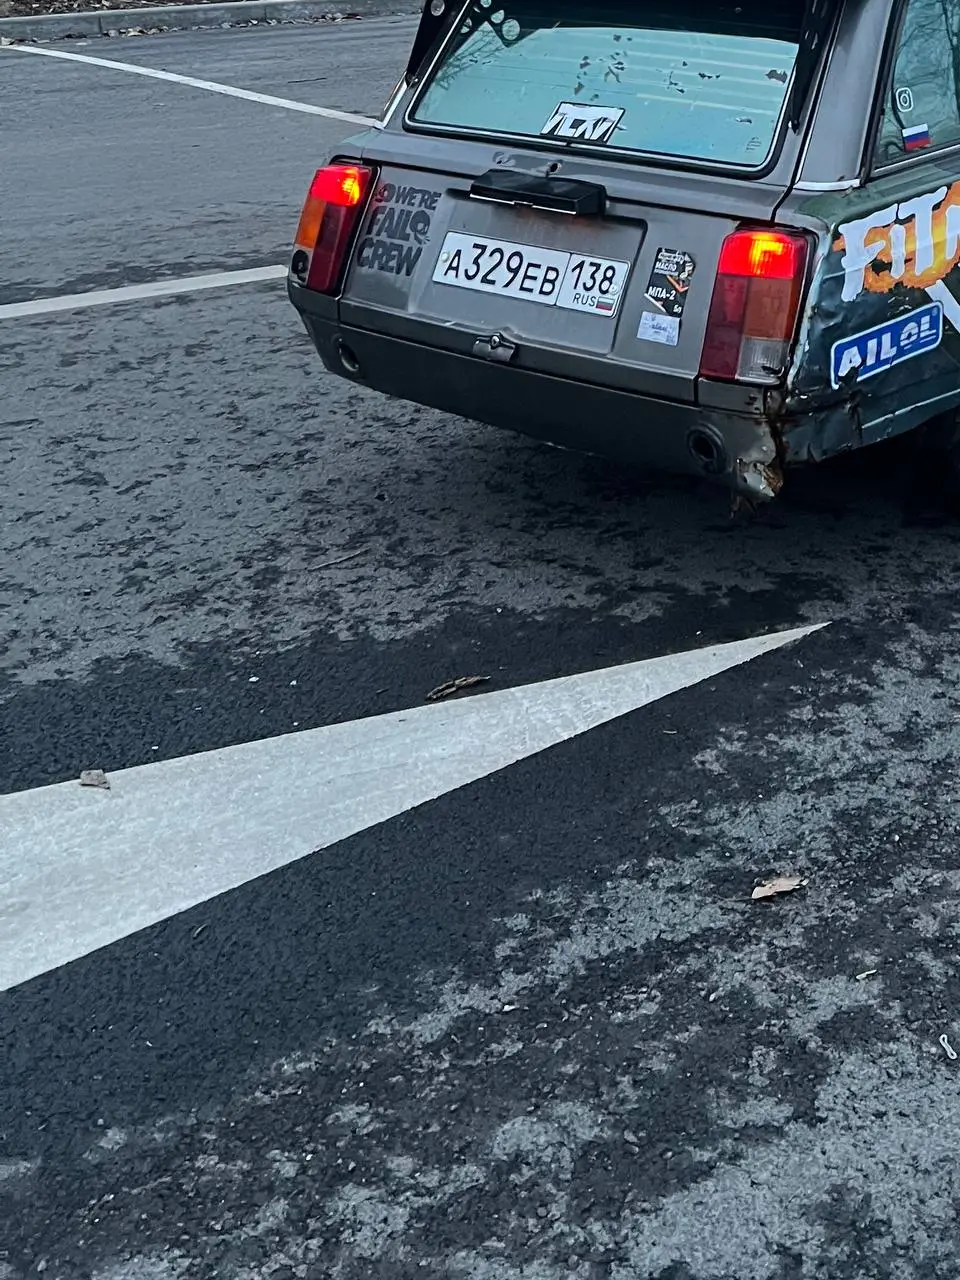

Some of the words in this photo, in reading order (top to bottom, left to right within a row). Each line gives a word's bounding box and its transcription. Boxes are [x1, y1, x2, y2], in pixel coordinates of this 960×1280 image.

[357, 237, 423, 276] CREW
[571, 259, 617, 296] 138
[572, 291, 596, 307] RUS
[648, 286, 676, 301] МПА-2
